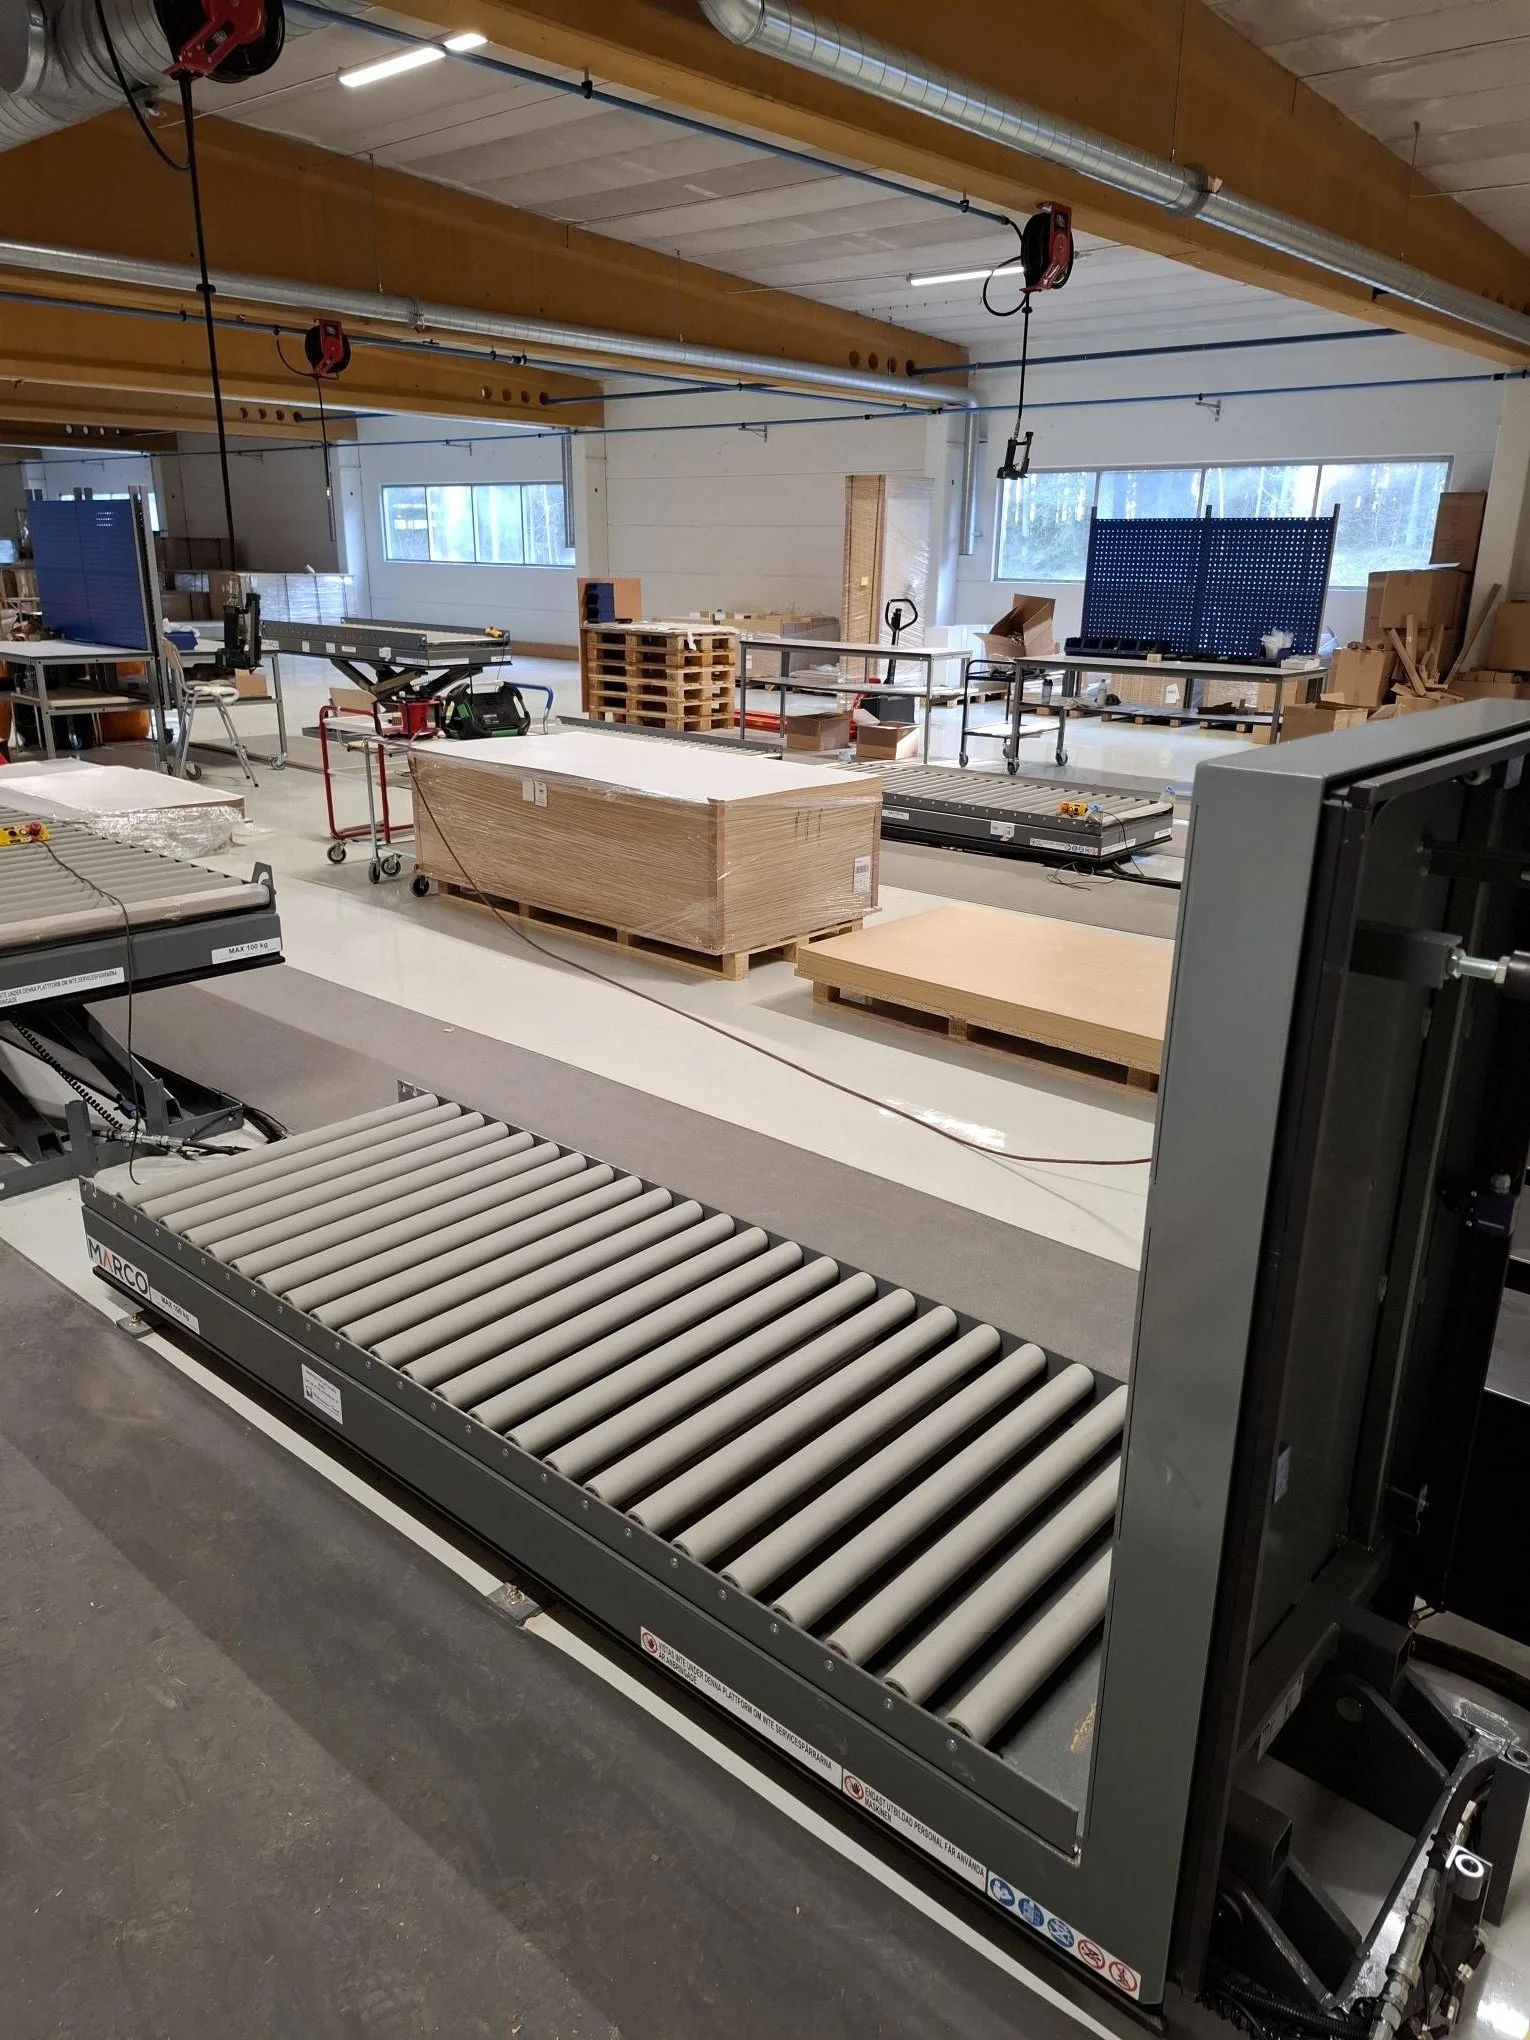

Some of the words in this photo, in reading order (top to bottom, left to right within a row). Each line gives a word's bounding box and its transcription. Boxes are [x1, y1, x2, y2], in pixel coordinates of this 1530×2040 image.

[37, 982, 61, 991] PLATTFORM
[87, 1238, 148, 1295] MARCO
[161, 1295, 172, 1309] MAX
[659, 1641, 674, 1659] VISTAS
[676, 1653, 687, 1668] INTE
[687, 1659, 703, 1680] UNDER
[704, 1672, 721, 1691] DENNA
[722, 1687, 753, 1714] PLATTFORM
[753, 1708, 762, 1721] OM
[762, 1715, 775, 1730] INTE
[864, 1798, 892, 1823] MASKINEN
[865, 1786, 886, 1806] ENDAST
[886, 1800, 913, 1827] UTBILDAD
[913, 1822, 943, 1849] PERSONAL
